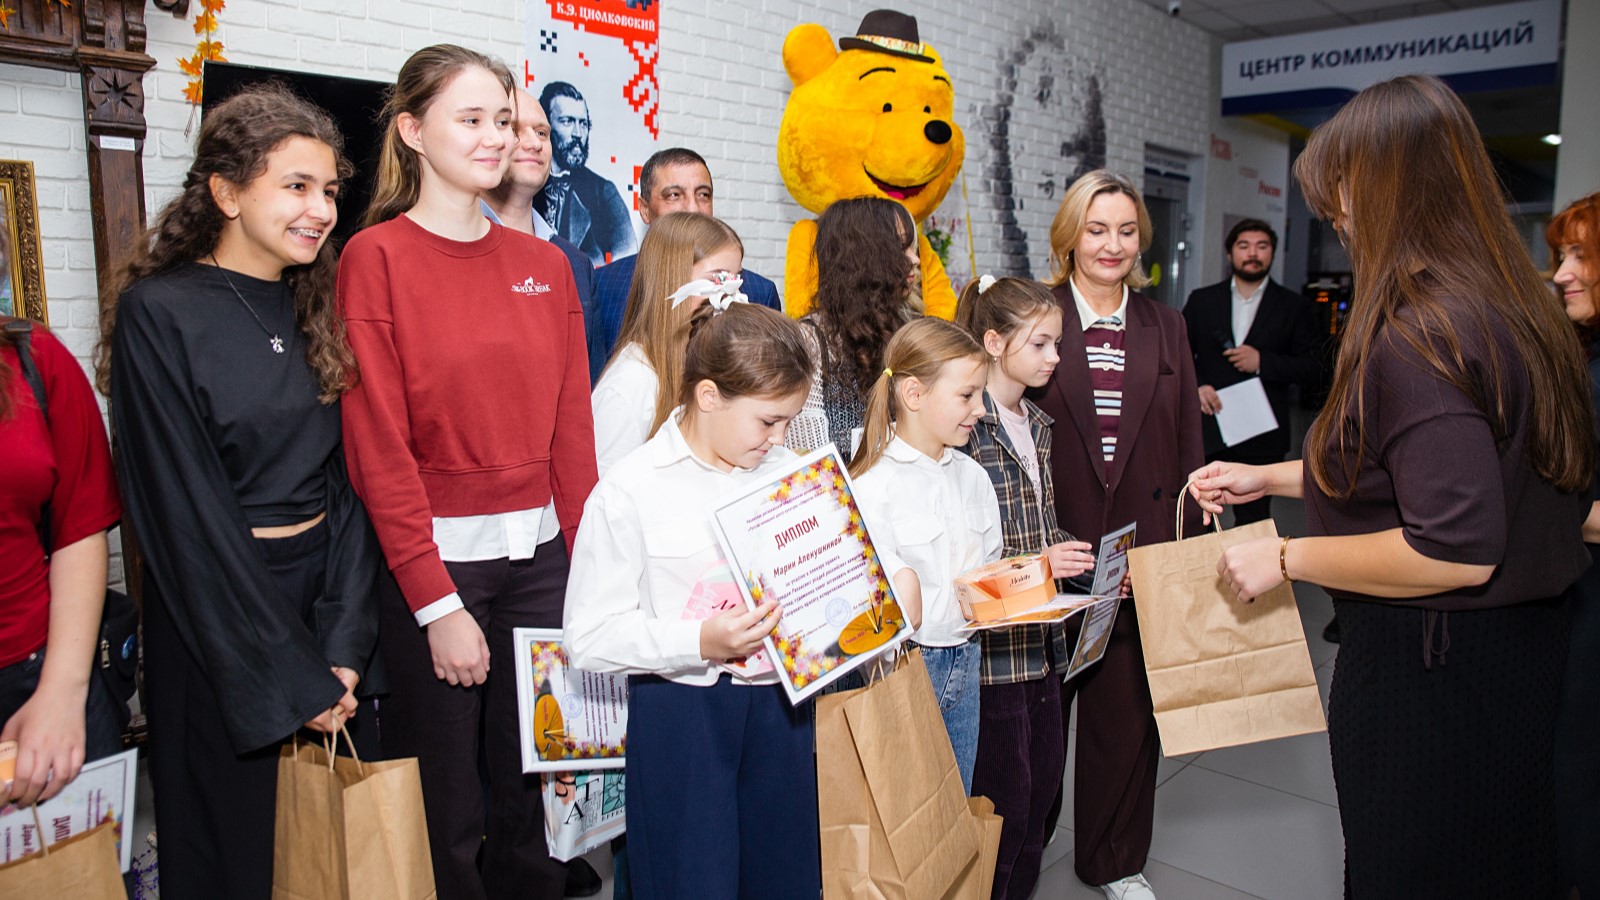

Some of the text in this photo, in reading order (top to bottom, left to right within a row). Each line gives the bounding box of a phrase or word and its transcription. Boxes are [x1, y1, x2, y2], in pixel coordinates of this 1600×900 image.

[579, 6, 655, 32] ЦИОЛКОВСКИЙ
[1239, 19, 1535, 78] ЦЕНТР КОММУНИКАЦИЙ
[774, 515, 819, 550] ДИПЛОМ
[773, 560, 796, 578] Марии
